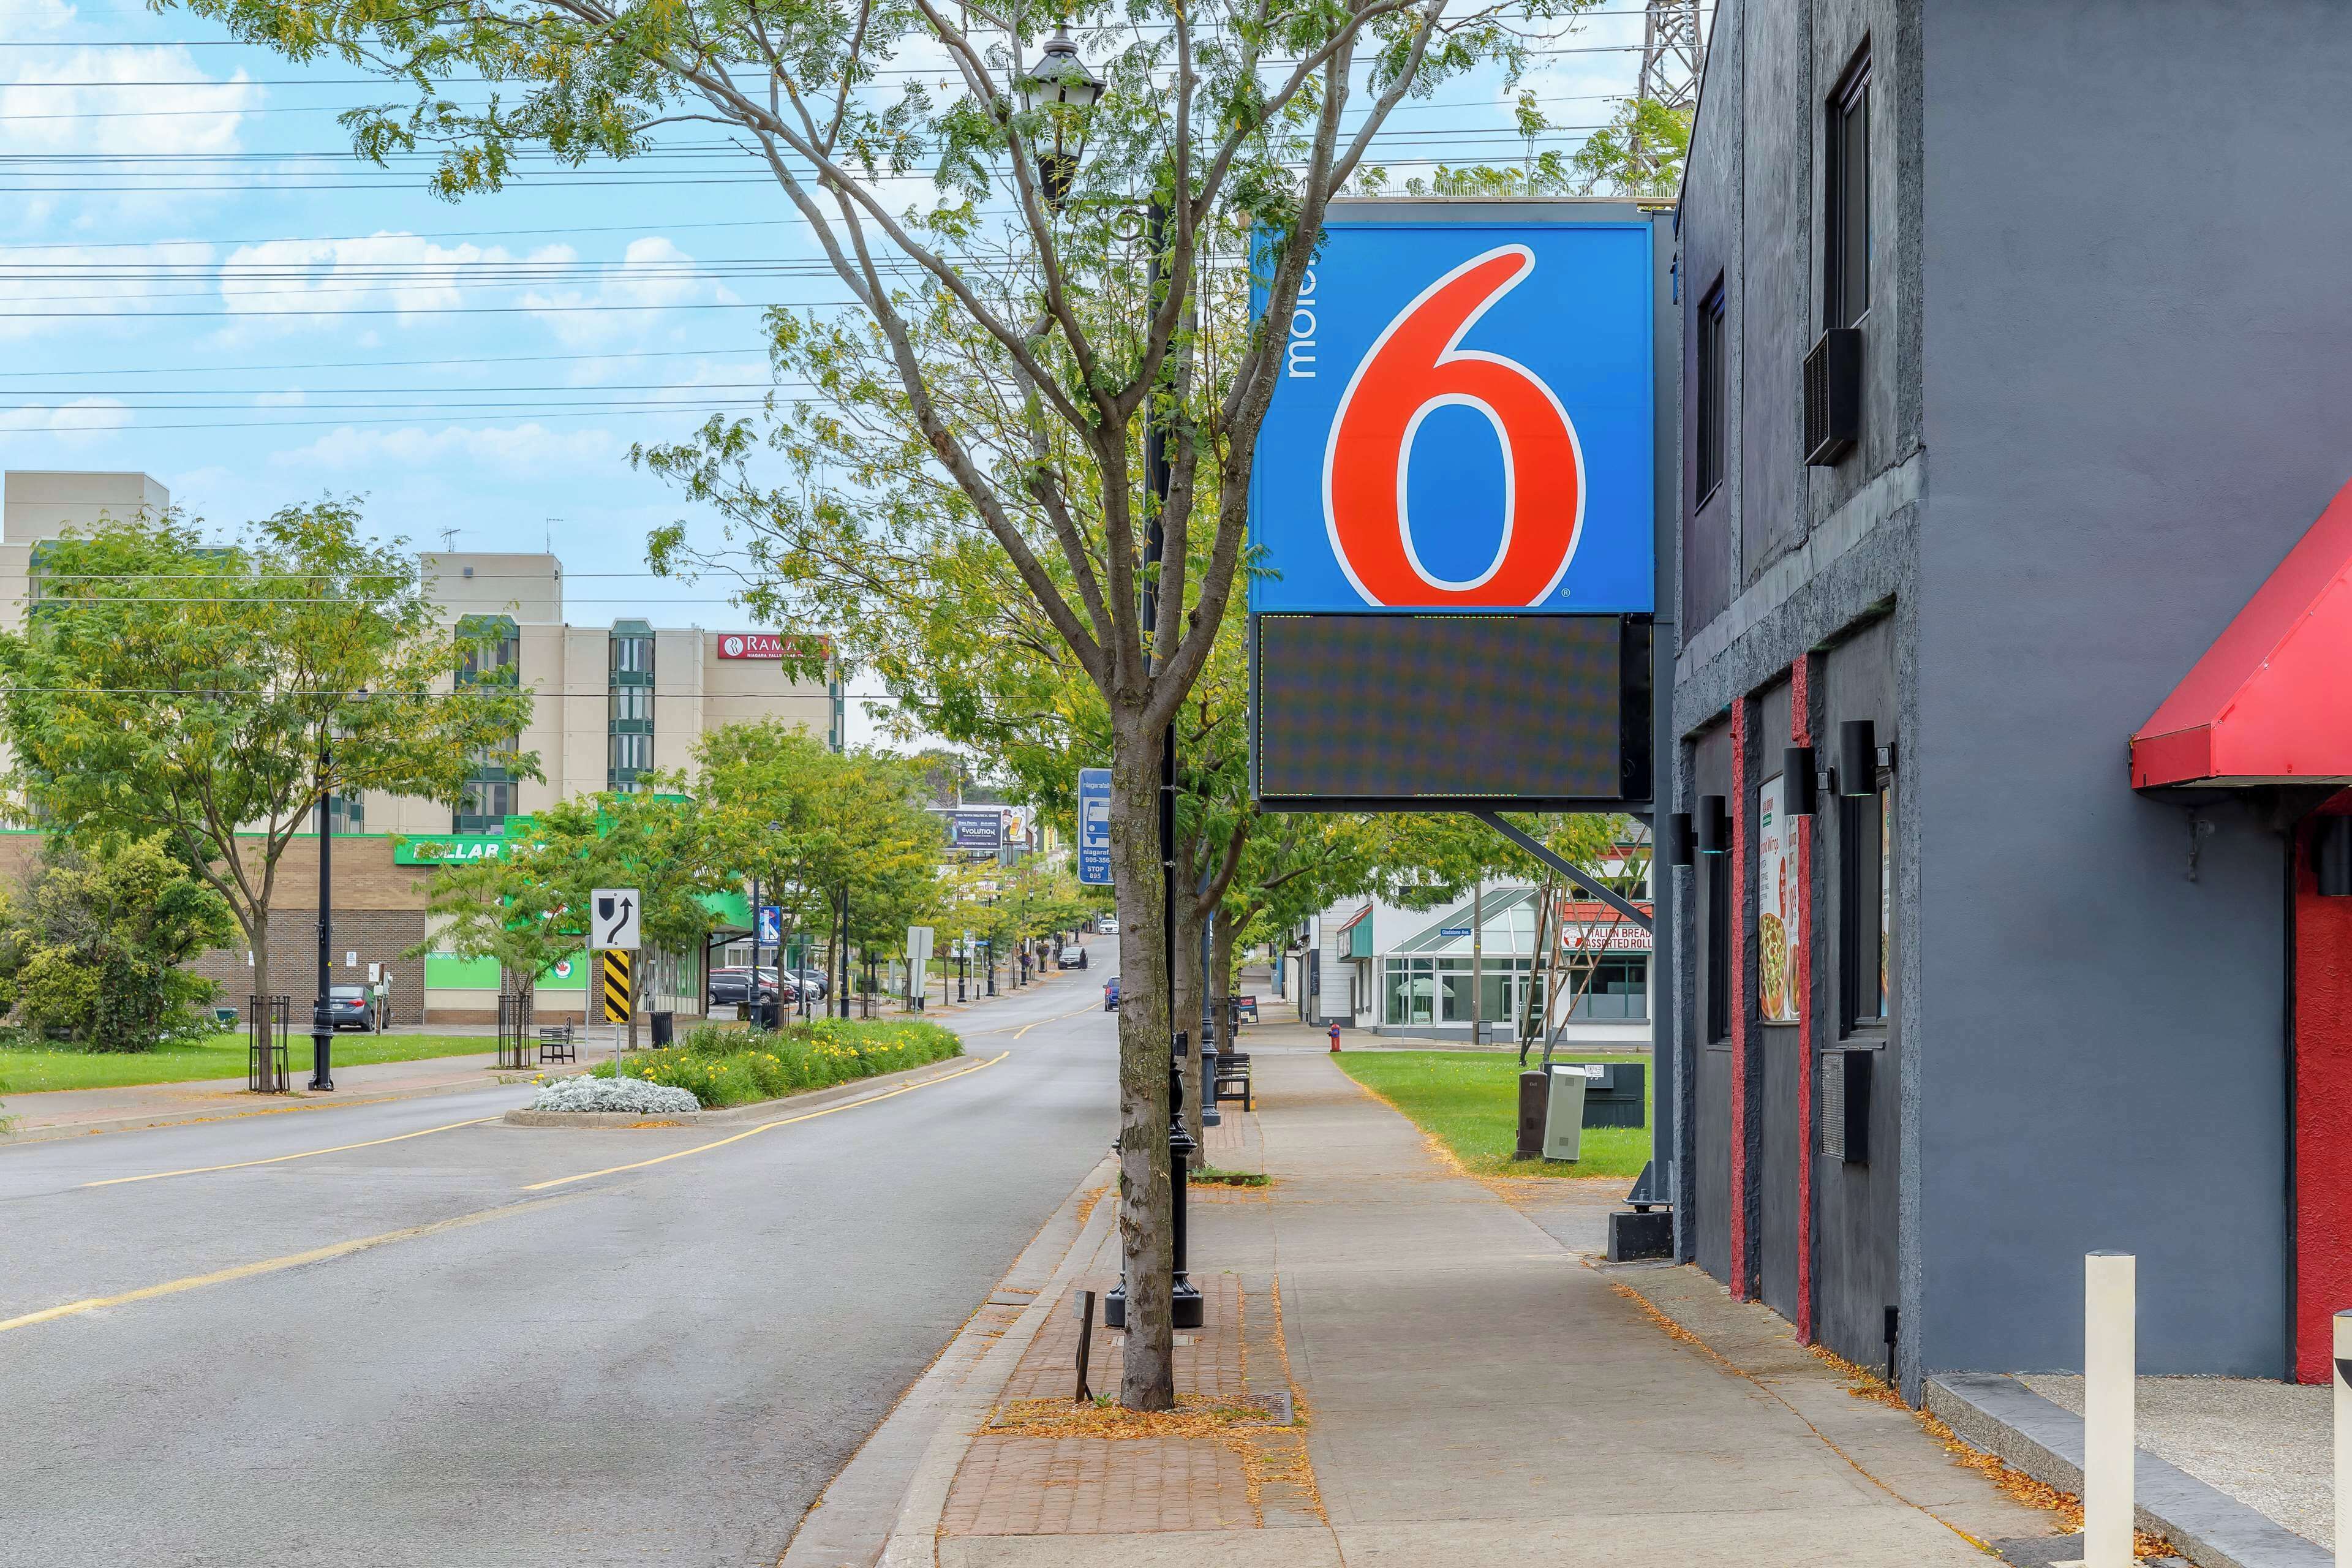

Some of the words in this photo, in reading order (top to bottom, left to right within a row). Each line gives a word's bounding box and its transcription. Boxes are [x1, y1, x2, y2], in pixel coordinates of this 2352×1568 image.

[1288, 259, 1316, 378] moe
[1322, 243, 1586, 607] 6
[747, 636, 798, 651] RAMA
[413, 843, 499, 859] LLAR
[1622, 929, 1651, 938] BREAD
[1586, 939, 1629, 948] ASSORTED
